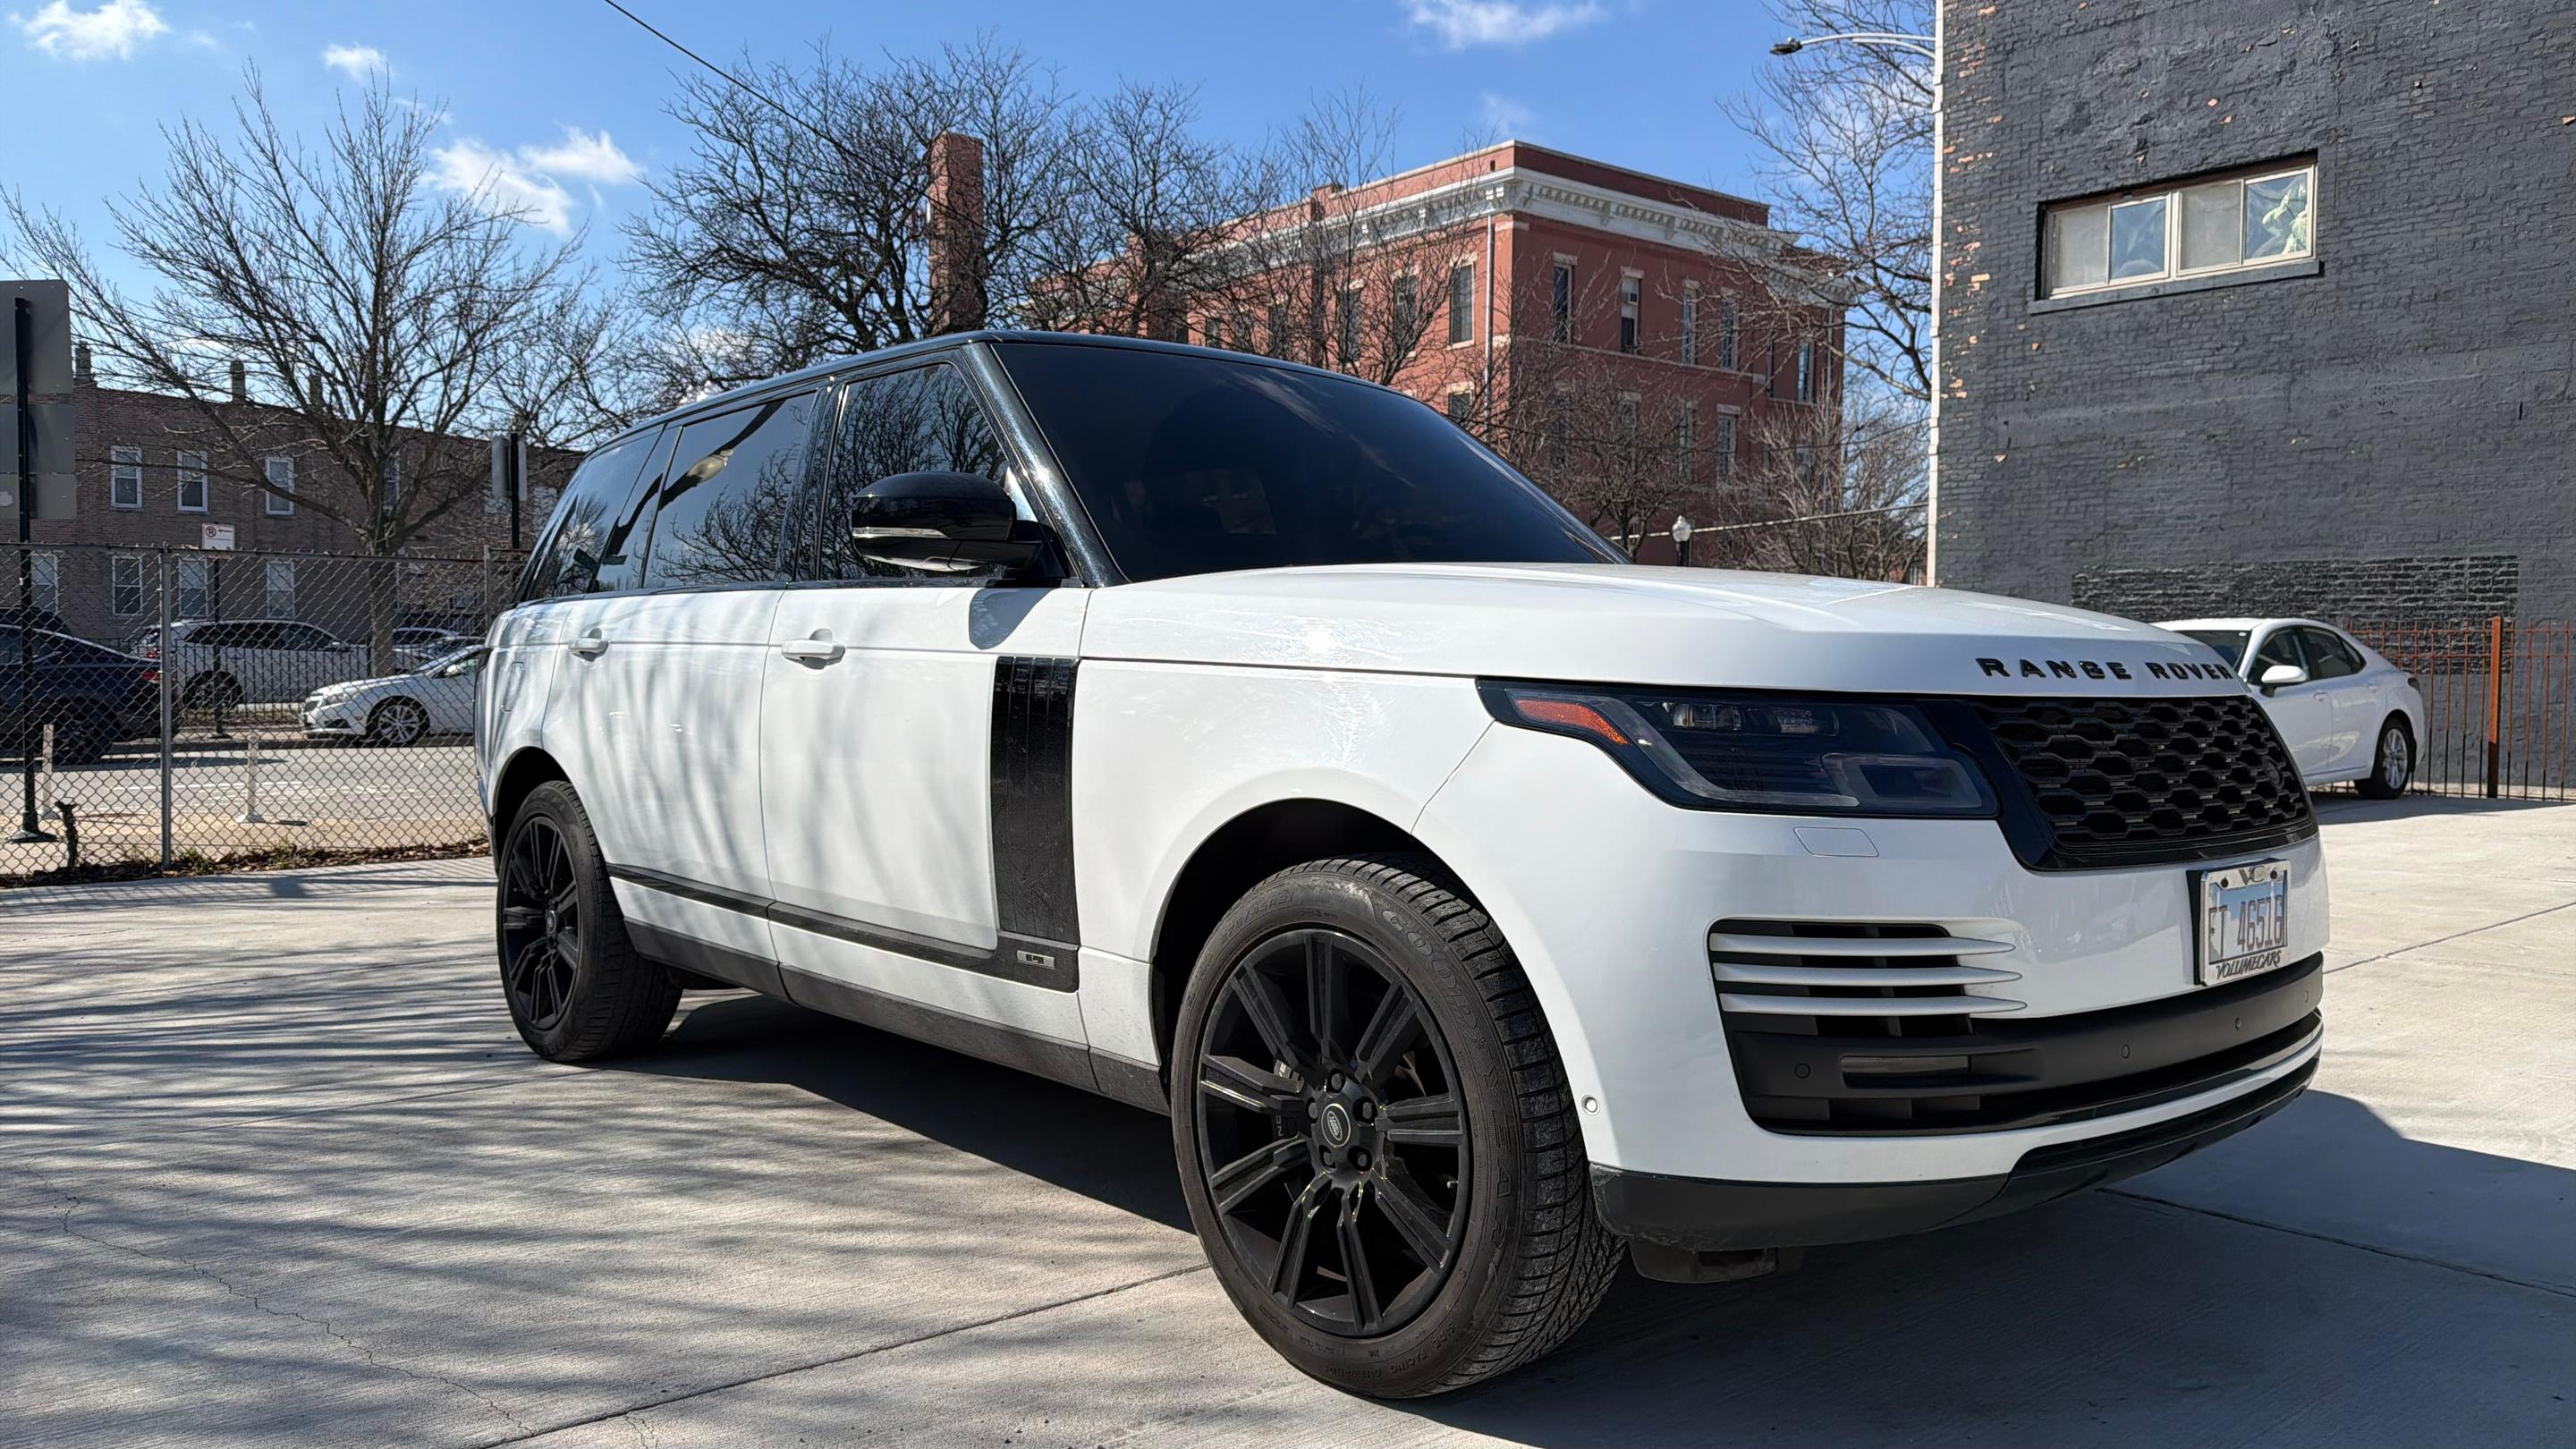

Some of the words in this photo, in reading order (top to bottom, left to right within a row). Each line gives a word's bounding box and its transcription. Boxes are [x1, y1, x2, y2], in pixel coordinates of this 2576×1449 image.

[1975, 657, 2132, 680] RANGE
[2146, 661, 2233, 680] ROVER
[2237, 895, 2283, 952] 46516
[2216, 950, 2282, 979] VOLUMECARS
[1381, 909, 1512, 1251] GOODYEAR
